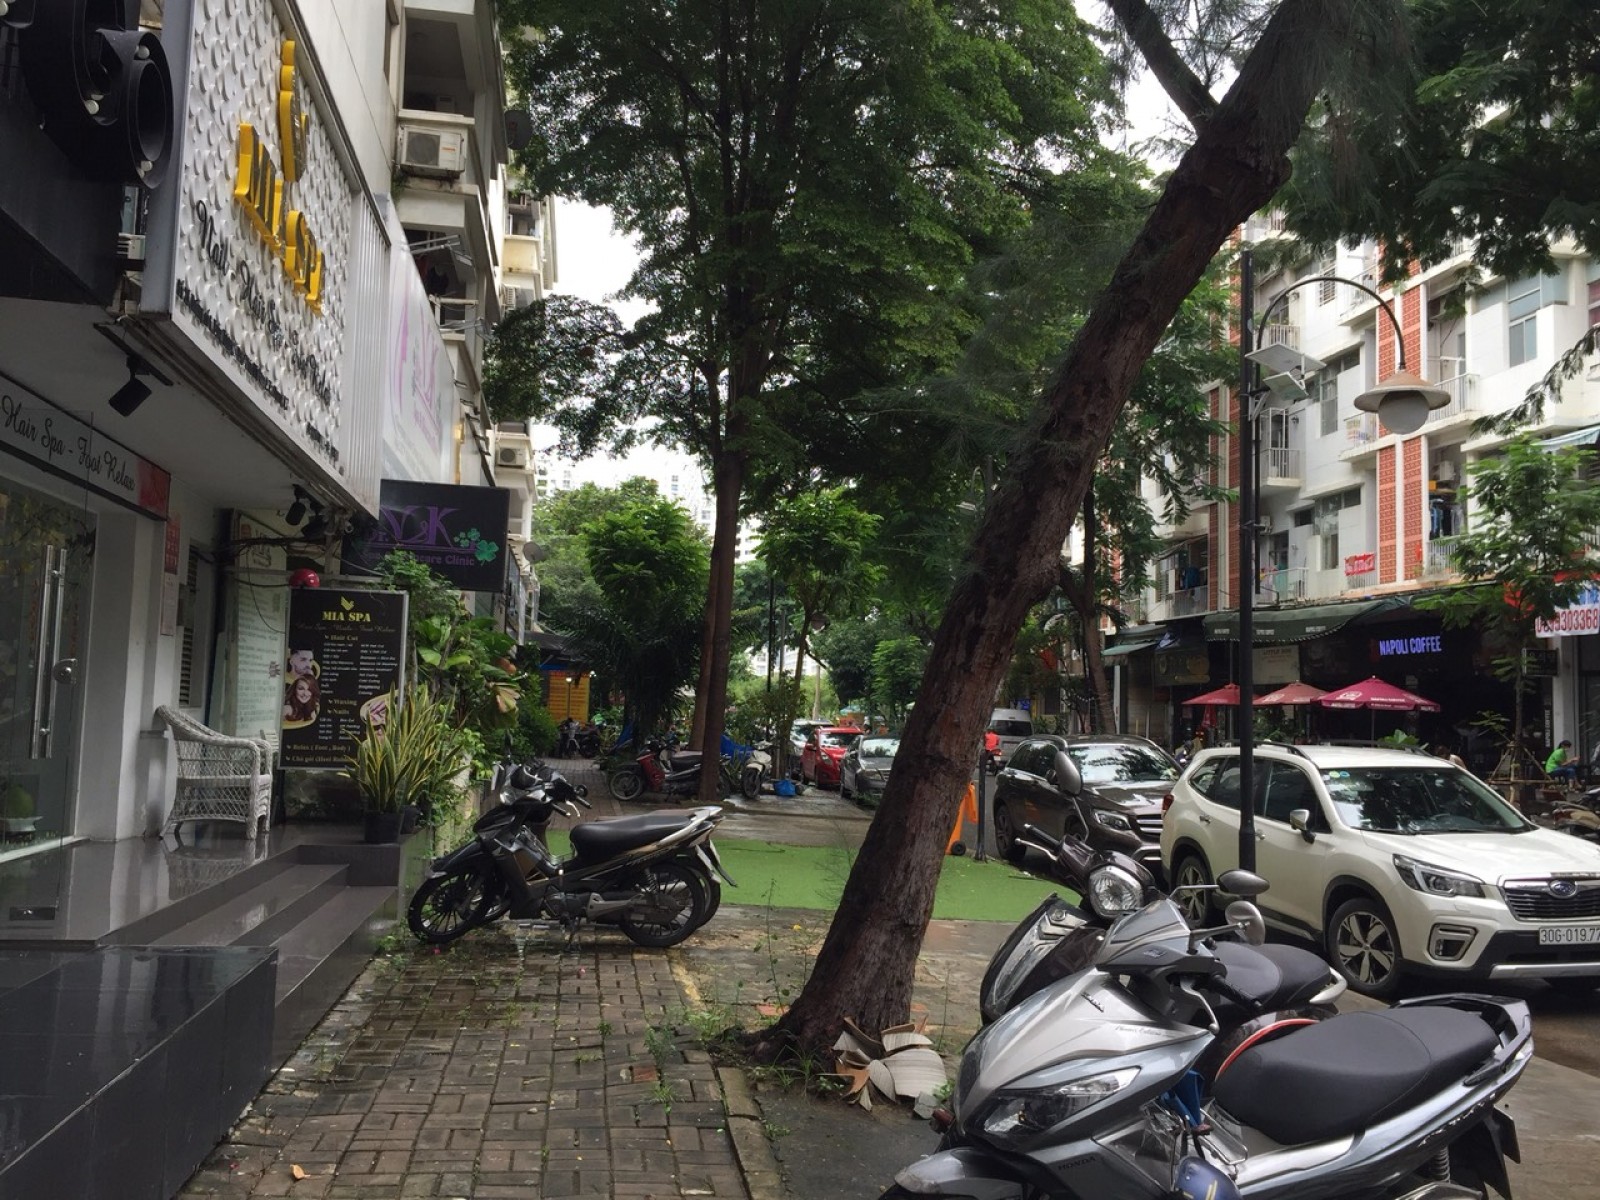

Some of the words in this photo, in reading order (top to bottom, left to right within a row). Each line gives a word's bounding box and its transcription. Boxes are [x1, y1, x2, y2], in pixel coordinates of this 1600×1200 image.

[1, 395, 37, 441] Hair
[41, 418, 65, 461] Spa
[104, 450, 136, 491] Relax
[445, 554, 475, 567] Clinic
[322, 611, 345, 621] MIA
[348, 612, 371, 622] SPA
[1379, 639, 1408, 656] NAPOLI
[1410, 636, 1442, 653] COFFEE
